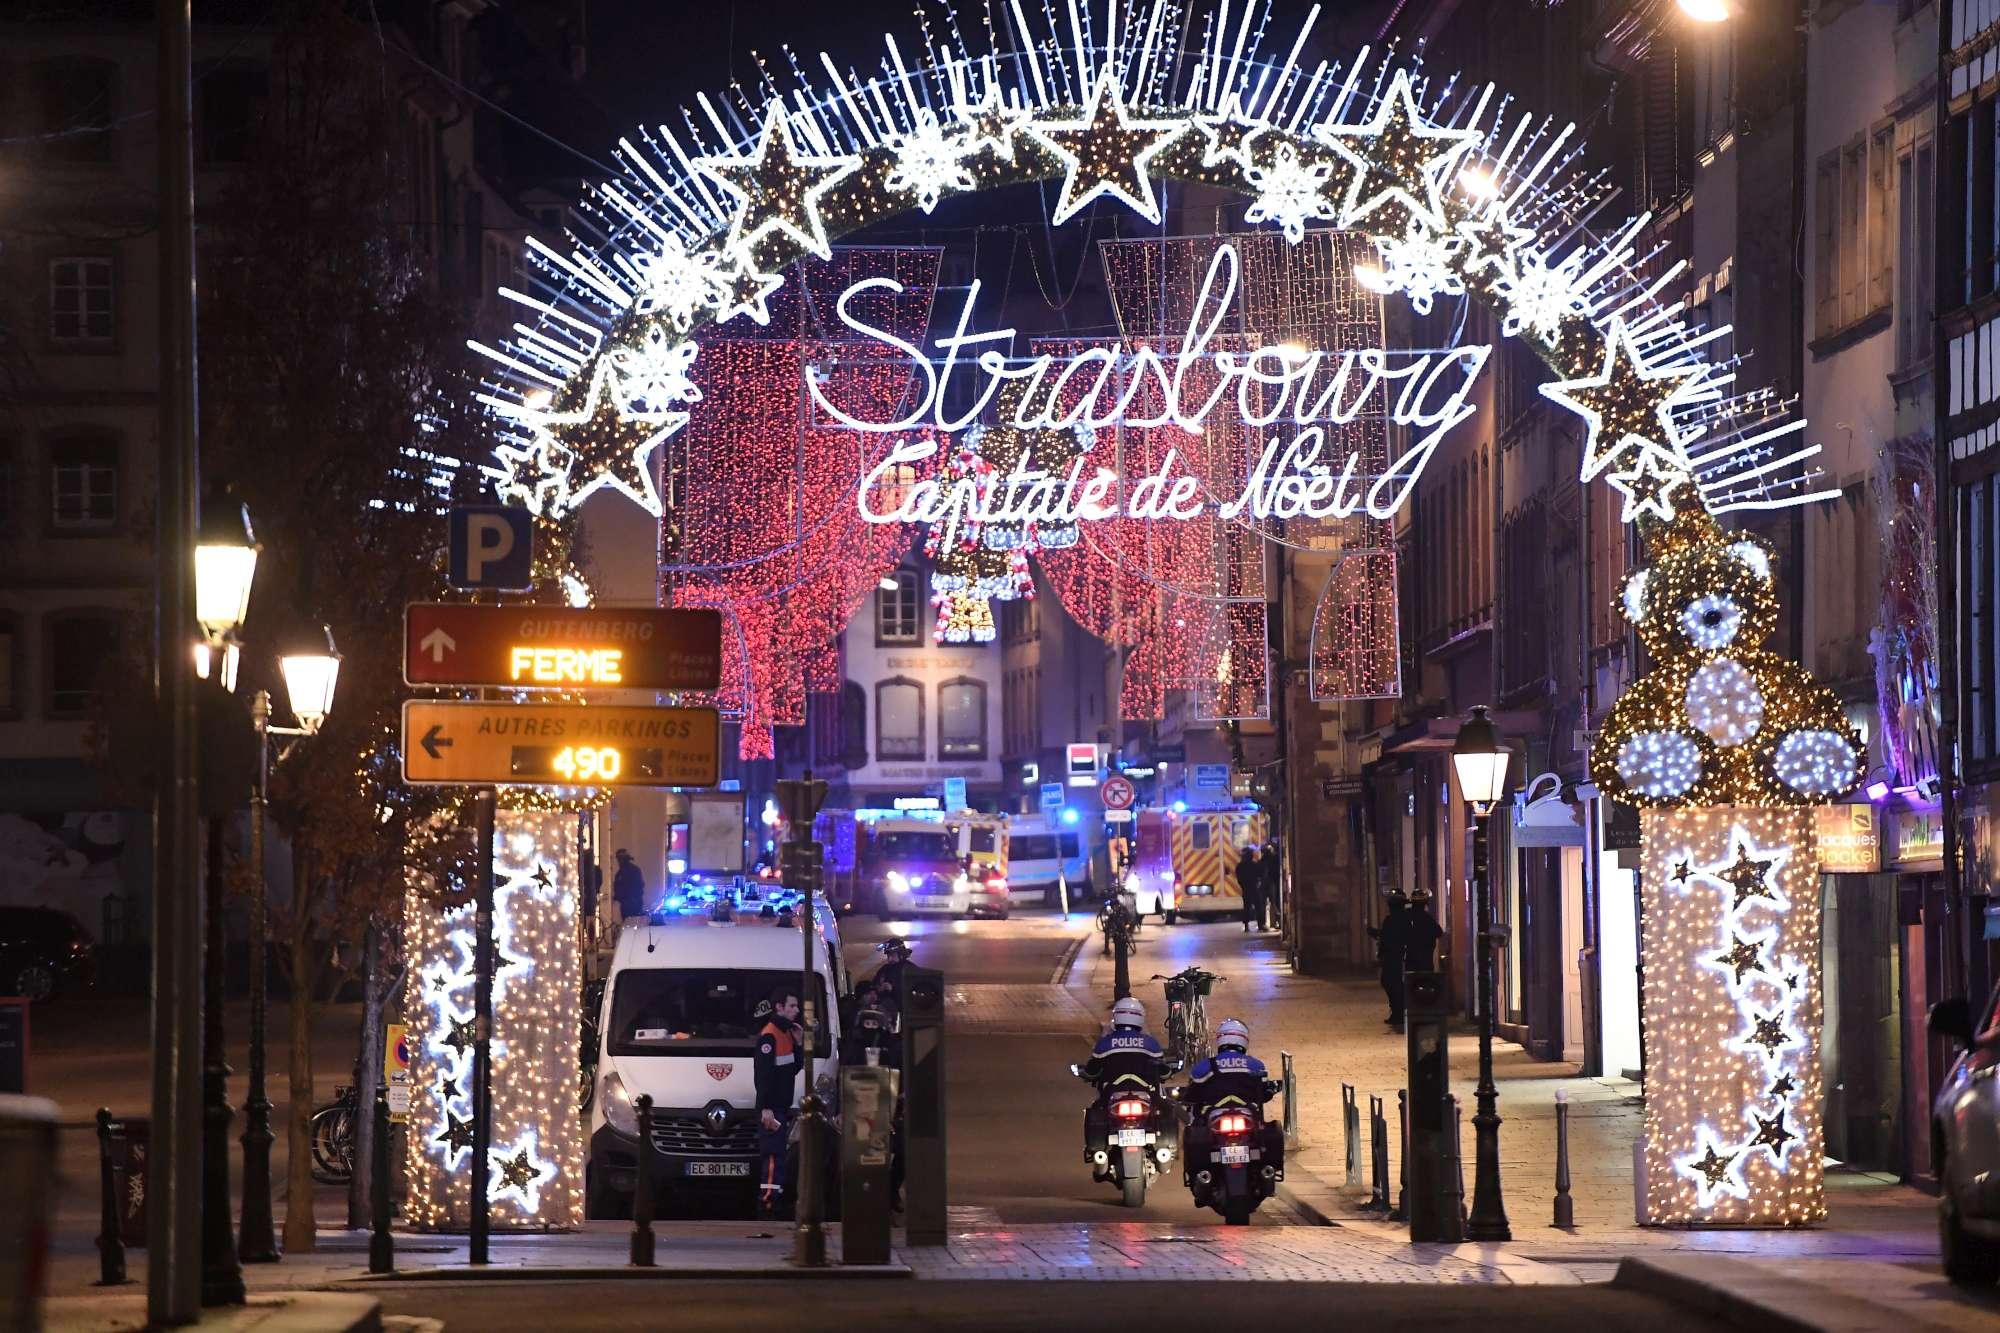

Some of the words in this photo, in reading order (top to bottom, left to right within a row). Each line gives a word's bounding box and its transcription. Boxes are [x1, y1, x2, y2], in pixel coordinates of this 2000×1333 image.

[806, 243, 1492, 521] Strasbourg
[857, 438, 1119, 553] Capitale
[1128, 448, 1203, 521] de
[1217, 425, 1361, 521] Noël
[466, 513, 514, 582] P
[519, 619, 654, 640] GUTENBERG
[510, 645, 623, 684] FERME
[478, 717, 567, 737] AUTRES
[577, 719, 693, 740] PARKINGS
[552, 746, 621, 780] 490
[1817, 833, 1877, 849] Jacques
[1112, 1037, 1144, 1048] POLICE
